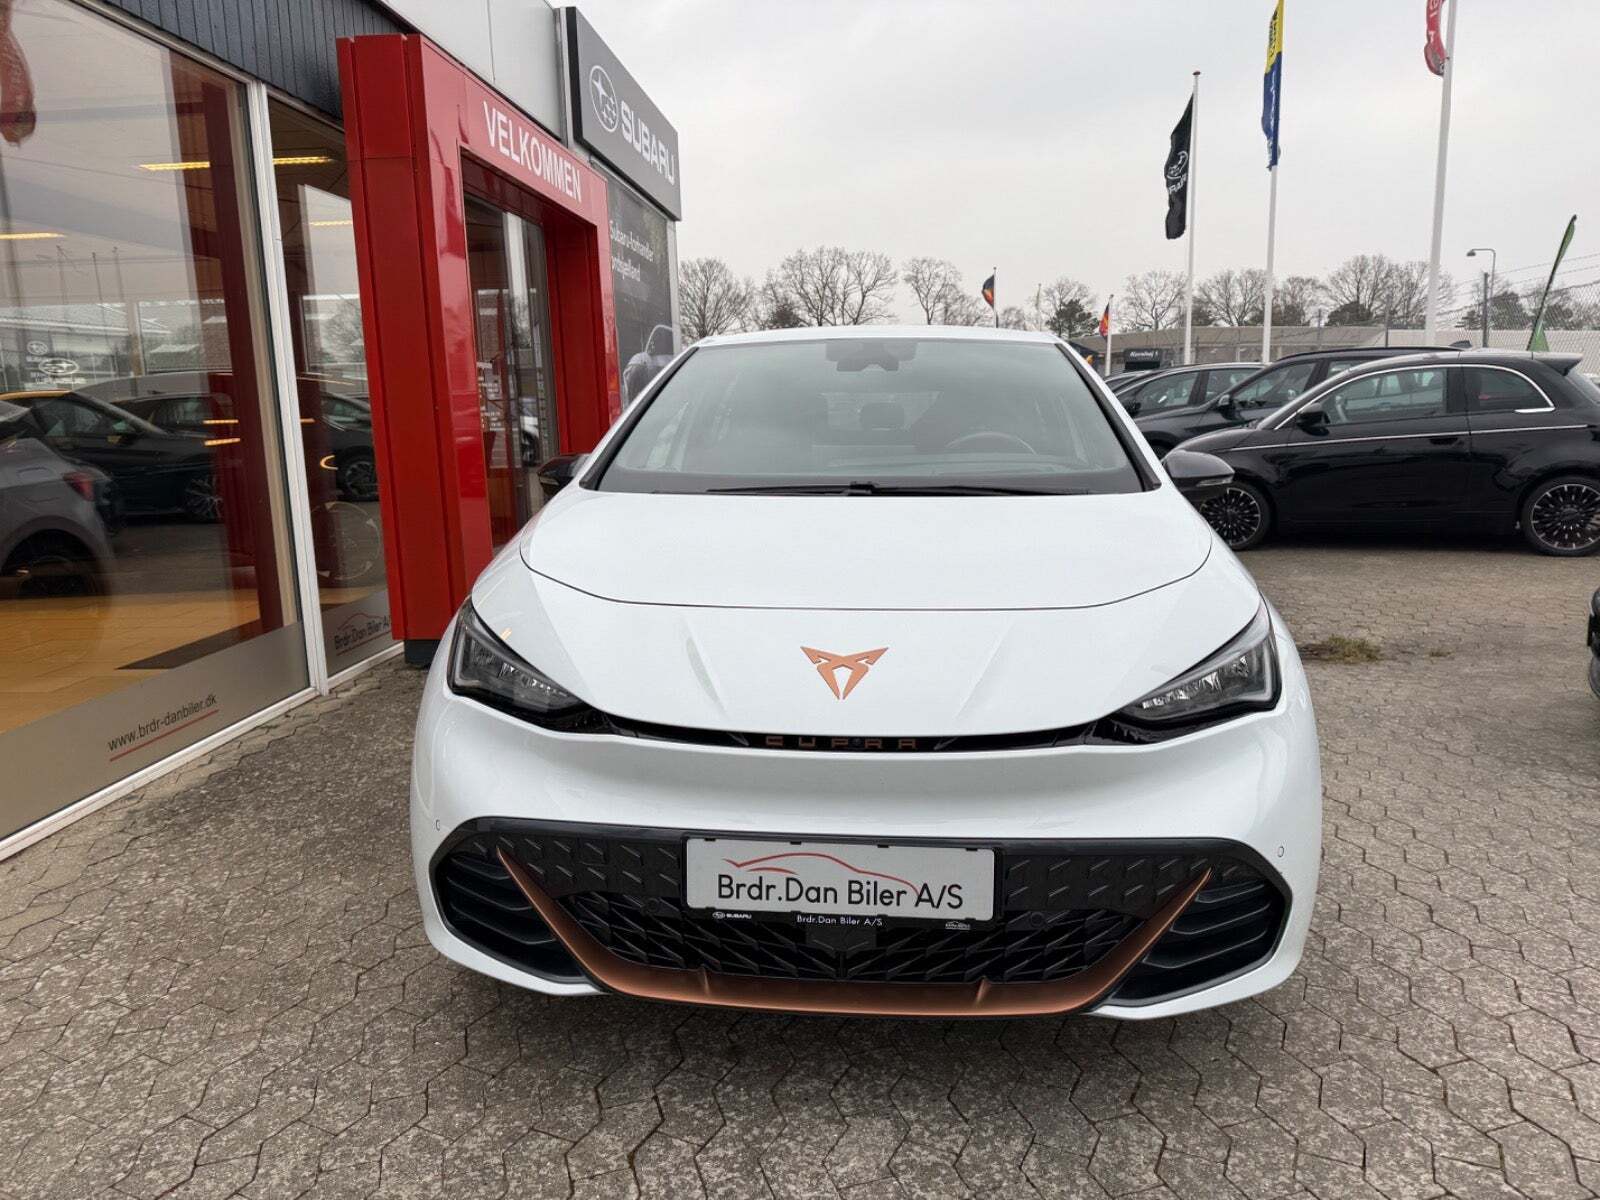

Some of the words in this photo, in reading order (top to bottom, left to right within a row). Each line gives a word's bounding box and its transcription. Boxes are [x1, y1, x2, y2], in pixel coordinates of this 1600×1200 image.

[483, 100, 582, 204] VELKOMMEN
[620, 100, 675, 186] SUBARU
[107, 692, 218, 752] www.brdr-danbiler.dk
[765, 735, 916, 750] CUPRA
[847, 879, 908, 907] Biler
[914, 882, 964, 910] A/S
[726, 912, 752, 920] SUBARU
[840, 916, 860, 926] Biler
[863, 917, 883, 927] A/S
